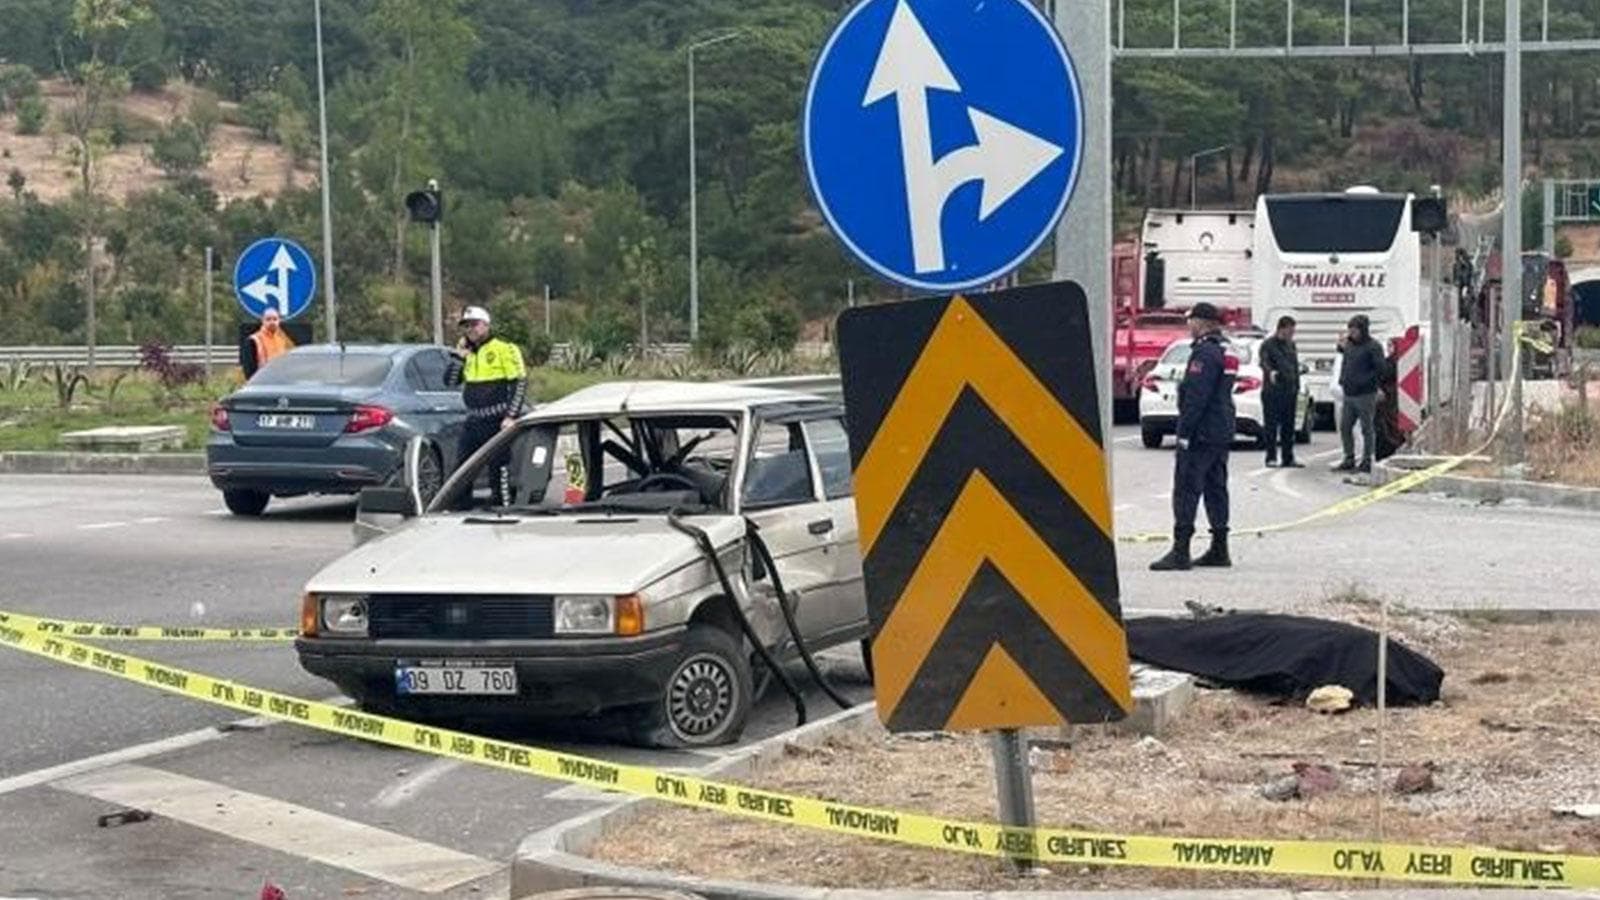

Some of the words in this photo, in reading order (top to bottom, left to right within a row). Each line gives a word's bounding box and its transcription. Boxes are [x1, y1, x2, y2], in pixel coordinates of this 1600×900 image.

[1282, 272, 1387, 288] PAMUKKALE
[408, 671, 429, 690] 09
[444, 671, 466, 691] DZ
[481, 671, 512, 690] 760
